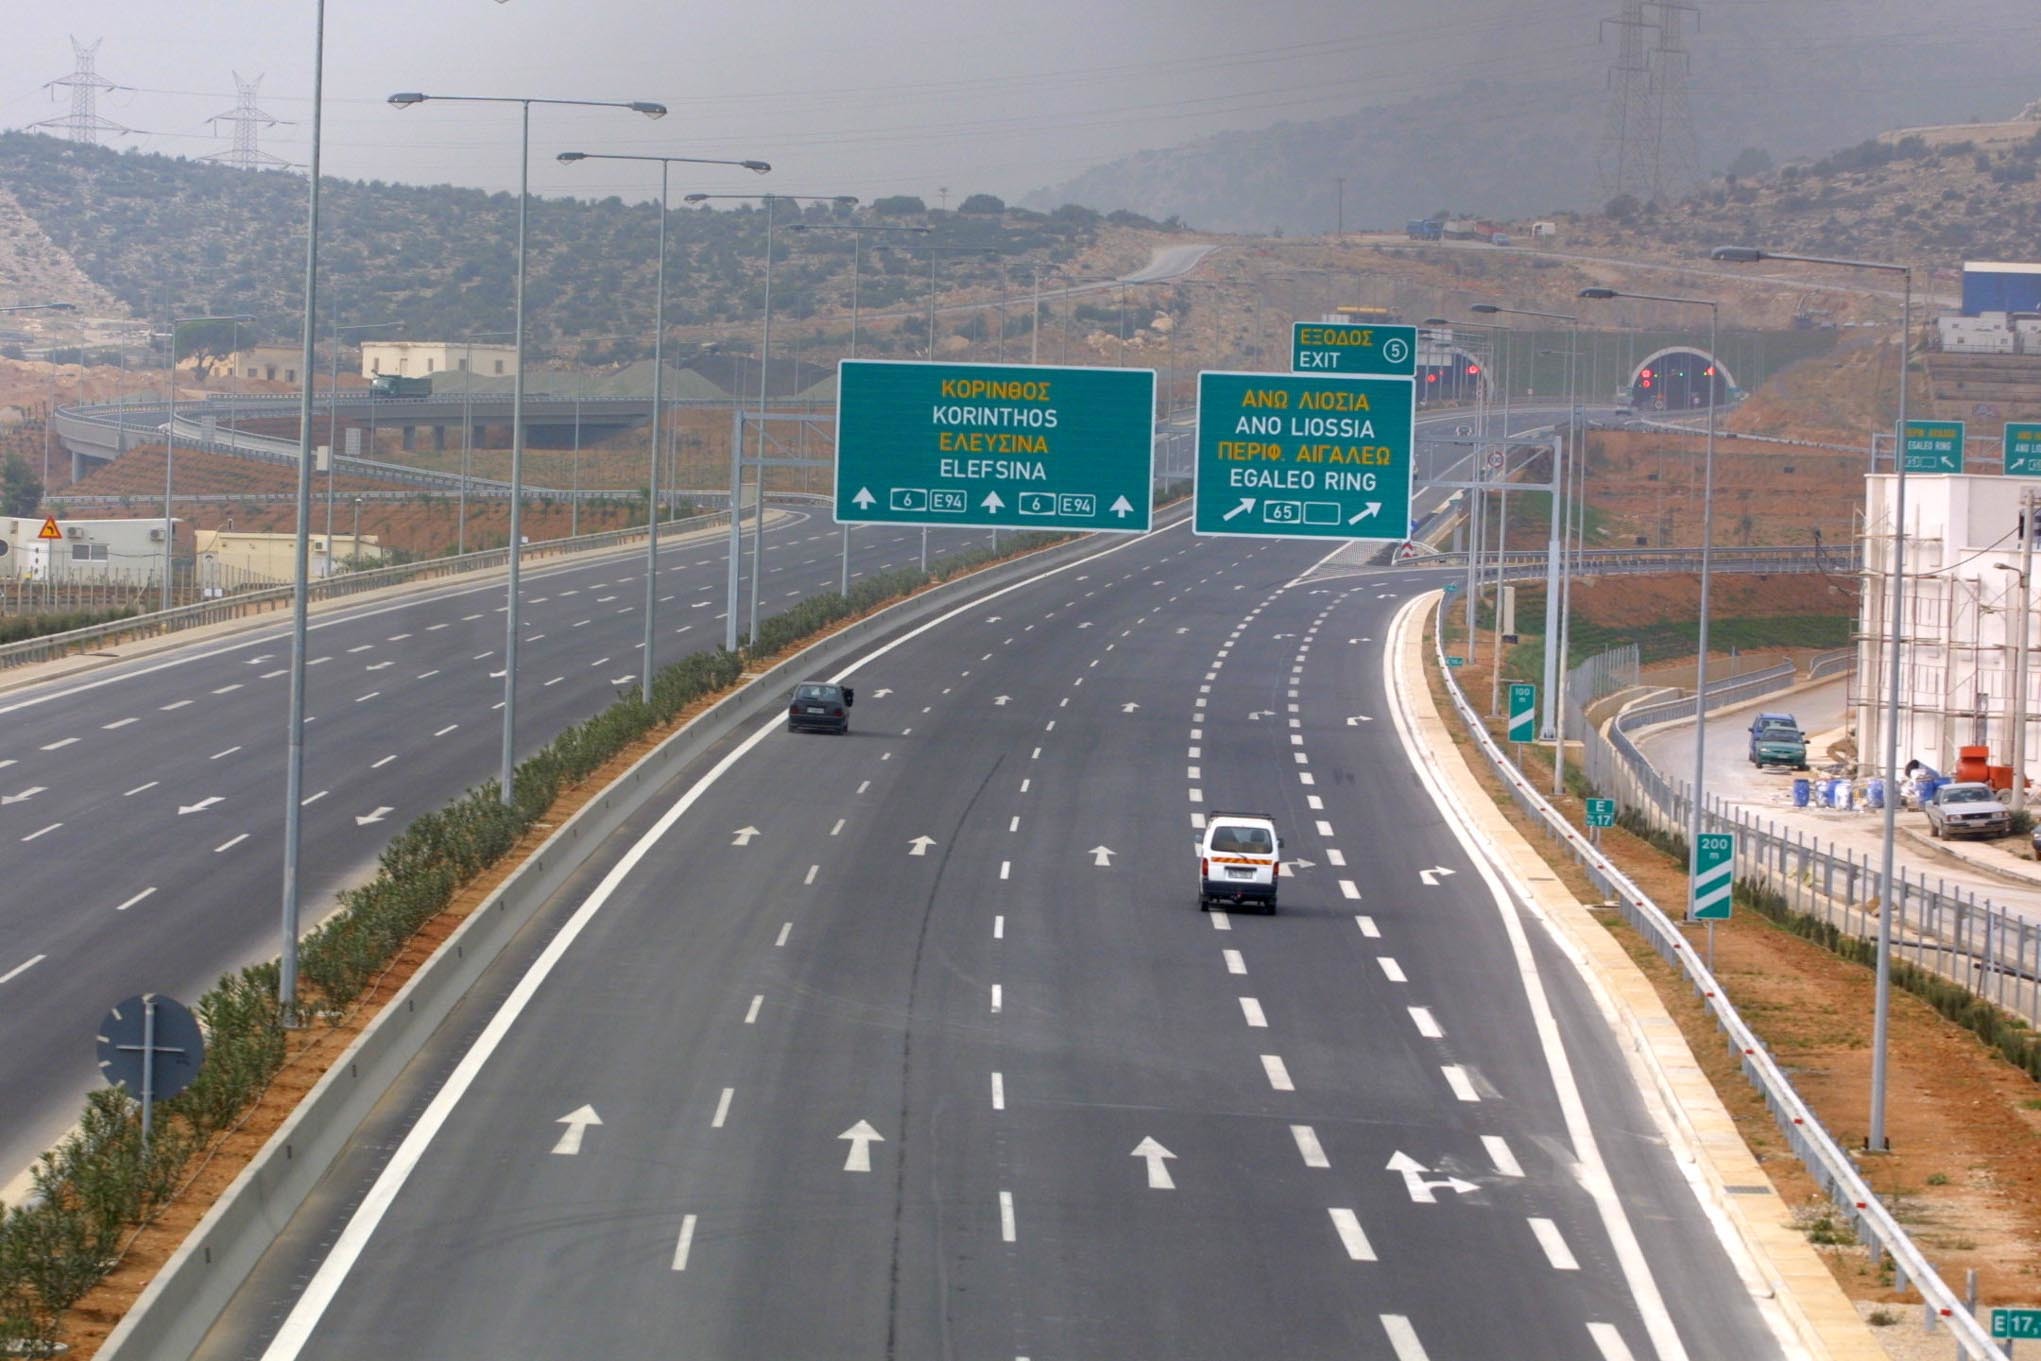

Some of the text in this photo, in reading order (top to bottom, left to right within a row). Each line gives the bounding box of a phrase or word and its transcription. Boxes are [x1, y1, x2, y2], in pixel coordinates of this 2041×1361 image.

[1301, 328, 1373, 346] ΕΞΟΔΟΣ
[1300, 352, 1341, 368] EXIT
[1391, 344, 1401, 358] 5
[941, 379, 1051, 401] ΚΟΡΙΝΘΟΣ
[1242, 390, 1370, 411] ΑΝΩ ΛΙΟΣΙΑ
[932, 406, 1058, 428] KORINTHOS
[1235, 416, 1375, 438] ANO LIOSSIA
[939, 432, 1049, 453] ΕΛΕΥΣΙΝΑ
[1218, 441, 1391, 465] ΠΕΡΙΦ. ΑΙΓΑΛΕΩ
[940, 459, 1047, 480] ELEFSINA
[1230, 469, 1377, 491] EGALEO RING
[903, 493, 1091, 514] 6 E94 6 E94
[1273, 505, 1293, 519] 65
[1596, 801, 1605, 812] E
[1597, 815, 1611, 826] 17
[1701, 838, 1728, 850] 200
[1994, 1316, 2006, 1331] E
